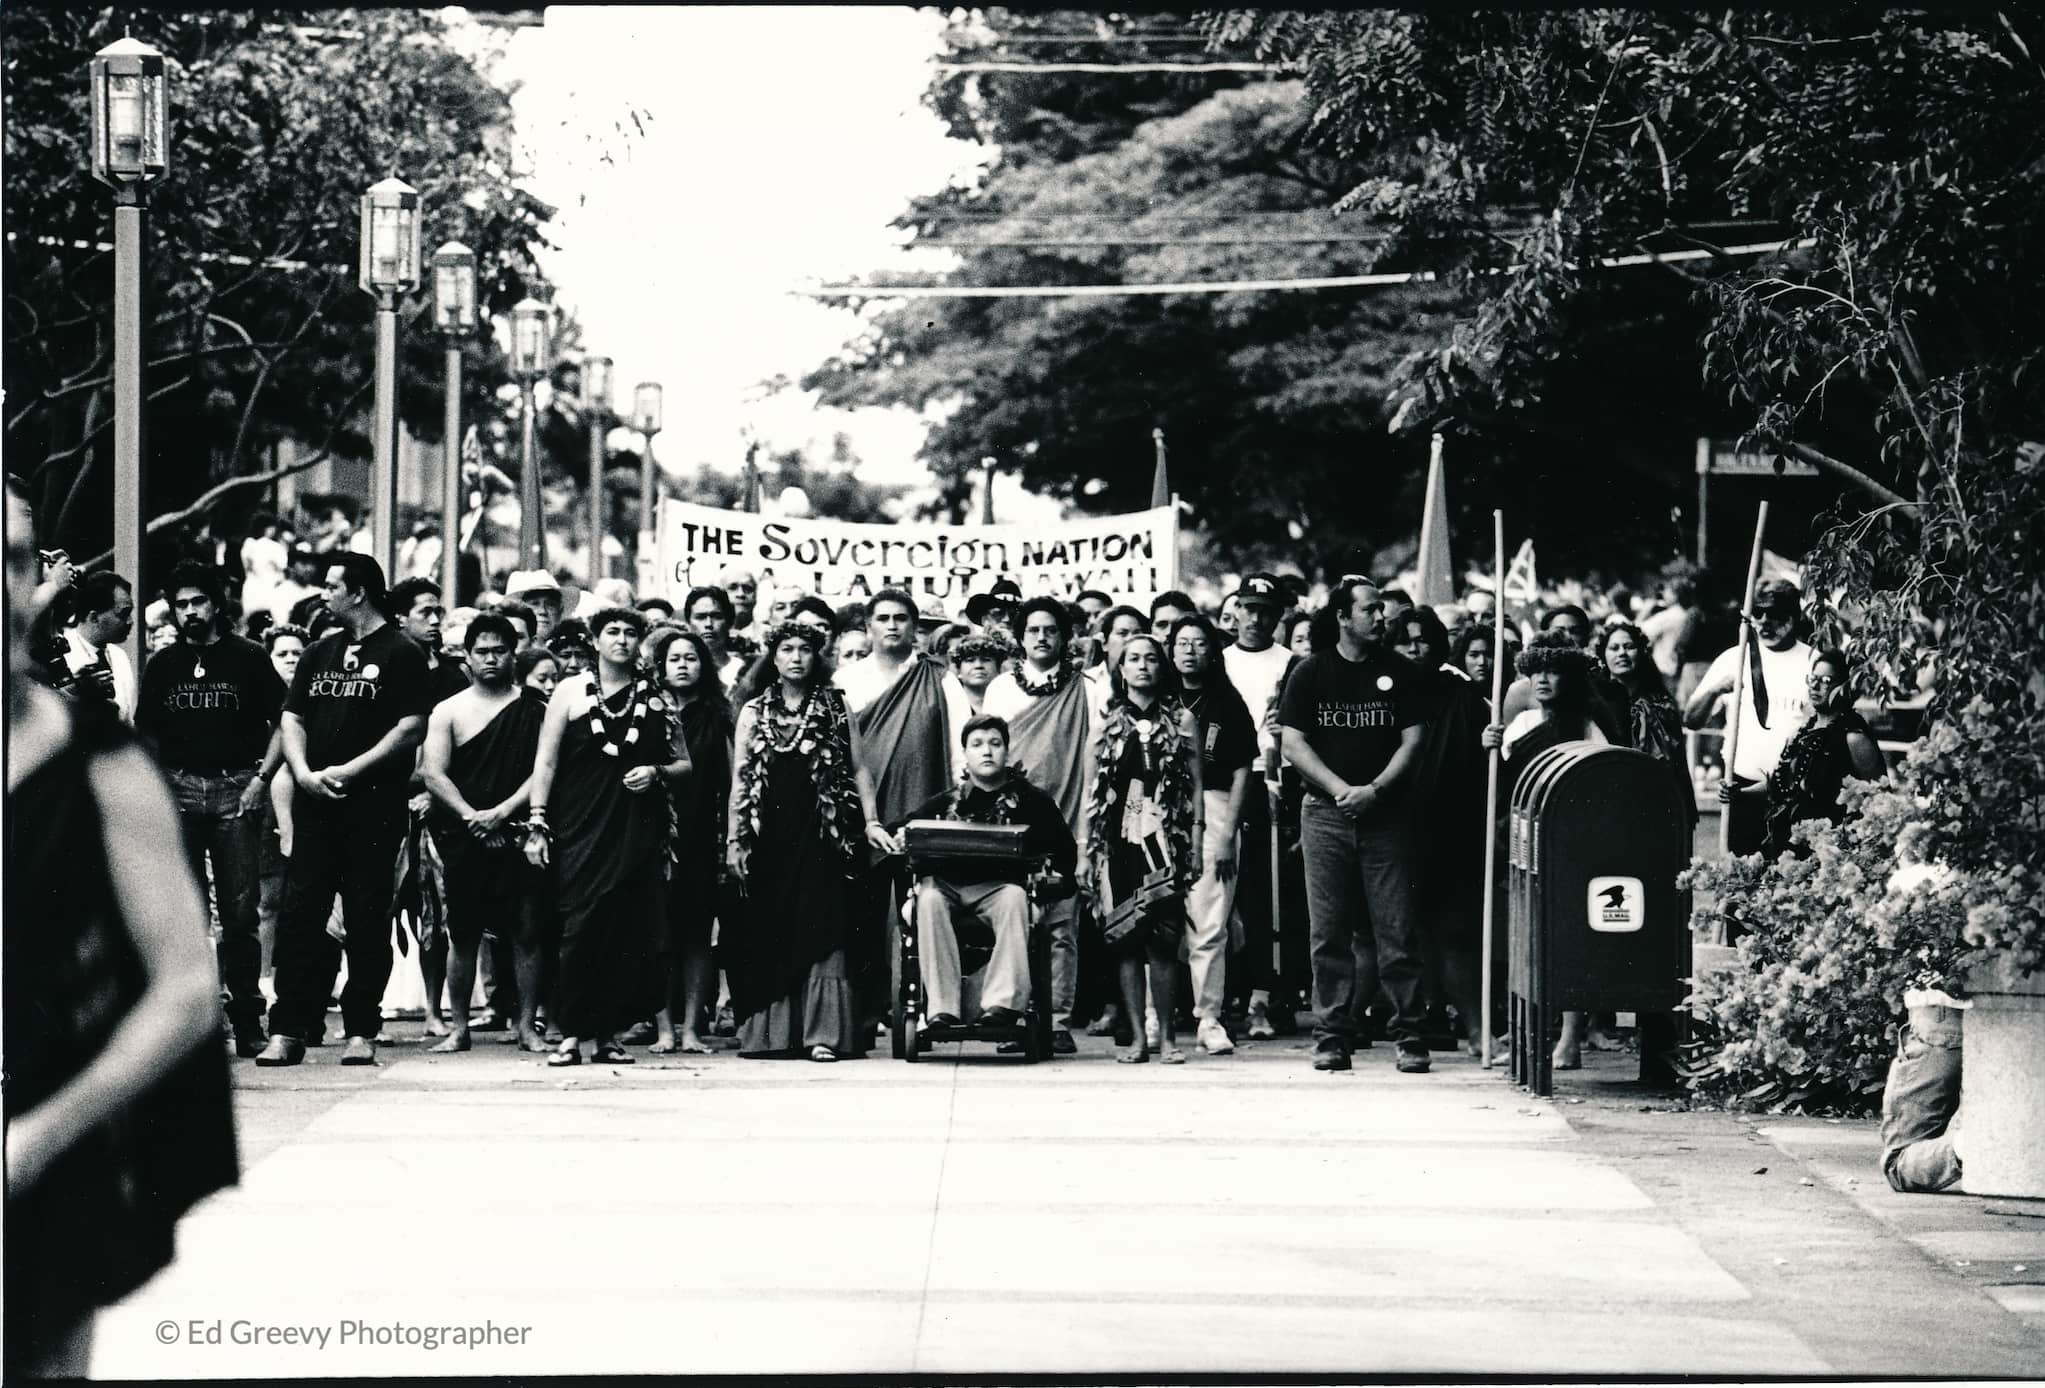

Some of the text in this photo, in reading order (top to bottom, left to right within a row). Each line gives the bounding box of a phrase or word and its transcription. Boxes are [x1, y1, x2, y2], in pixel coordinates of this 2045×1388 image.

[681, 522, 1154, 576] THE Sovereign NATION
[163, 690, 240, 713] ECURITY
[1317, 710, 1395, 729] SECURITY
